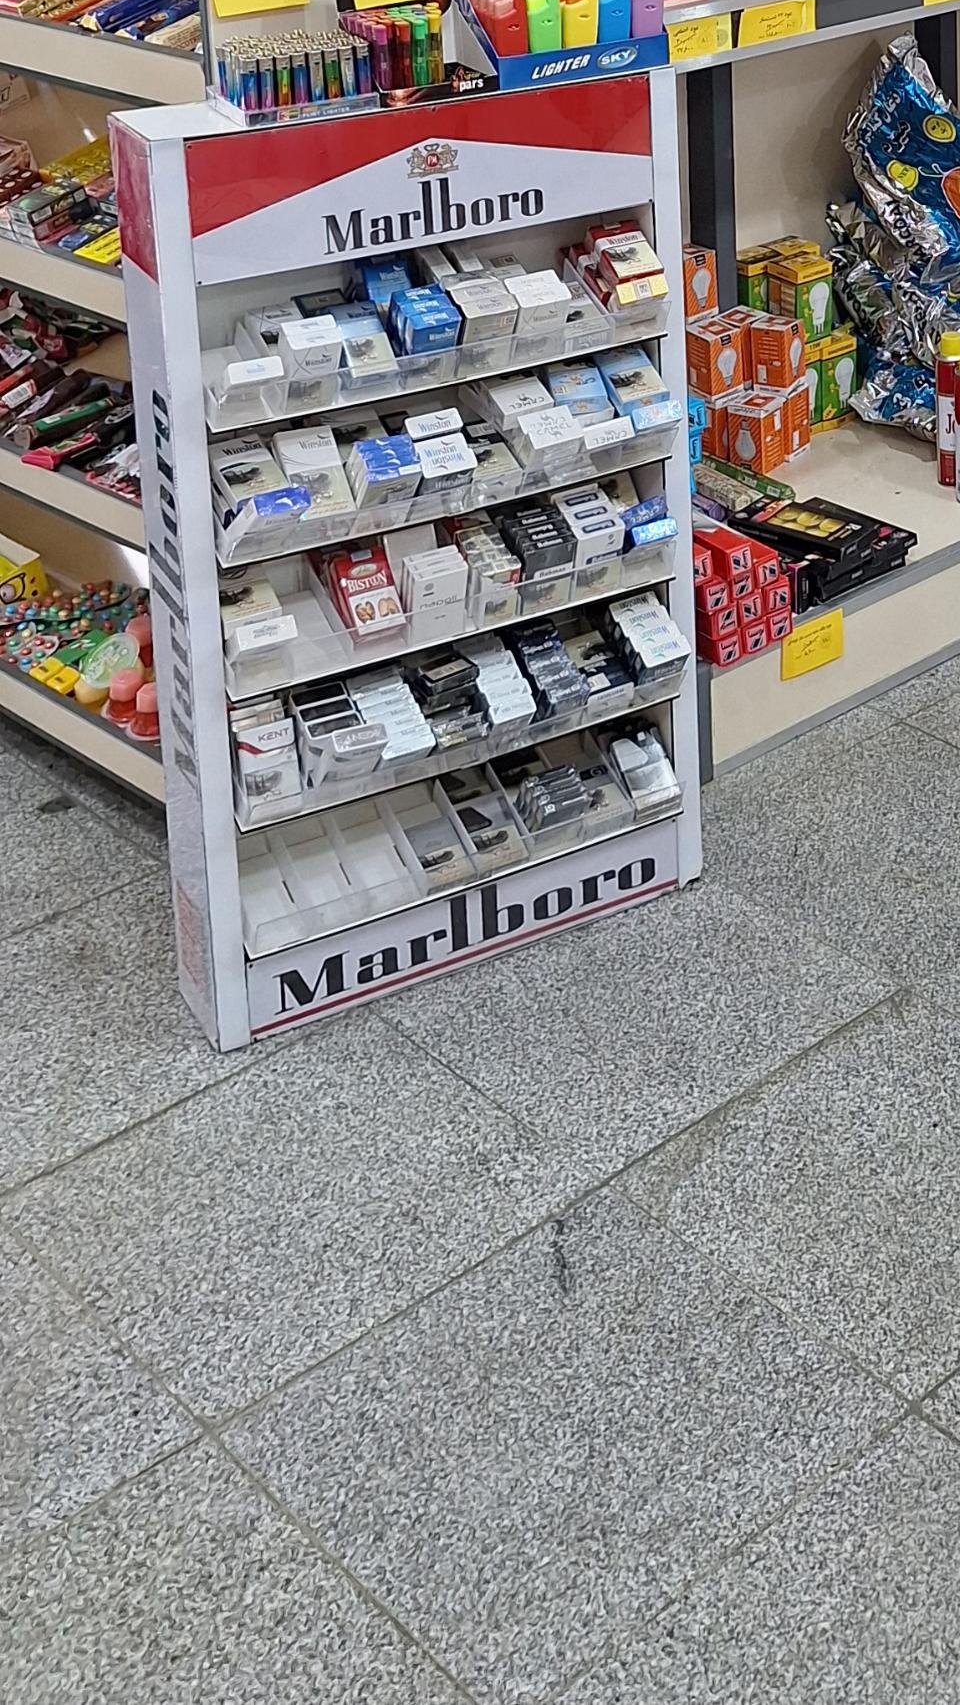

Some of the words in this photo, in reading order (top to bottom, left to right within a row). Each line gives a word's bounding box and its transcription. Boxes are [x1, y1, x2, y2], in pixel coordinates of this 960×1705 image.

[532, 54, 591, 80] LIGHTER
[599, 47, 637, 67] SKY
[459, 77, 485, 92] pars
[321, 178, 545, 256] Marlboro
[223, 442, 262, 457] Winston
[149, 389, 200, 787] Marlboro
[257, 727, 290, 743] KENT
[273, 855, 657, 1015] Marlboro
